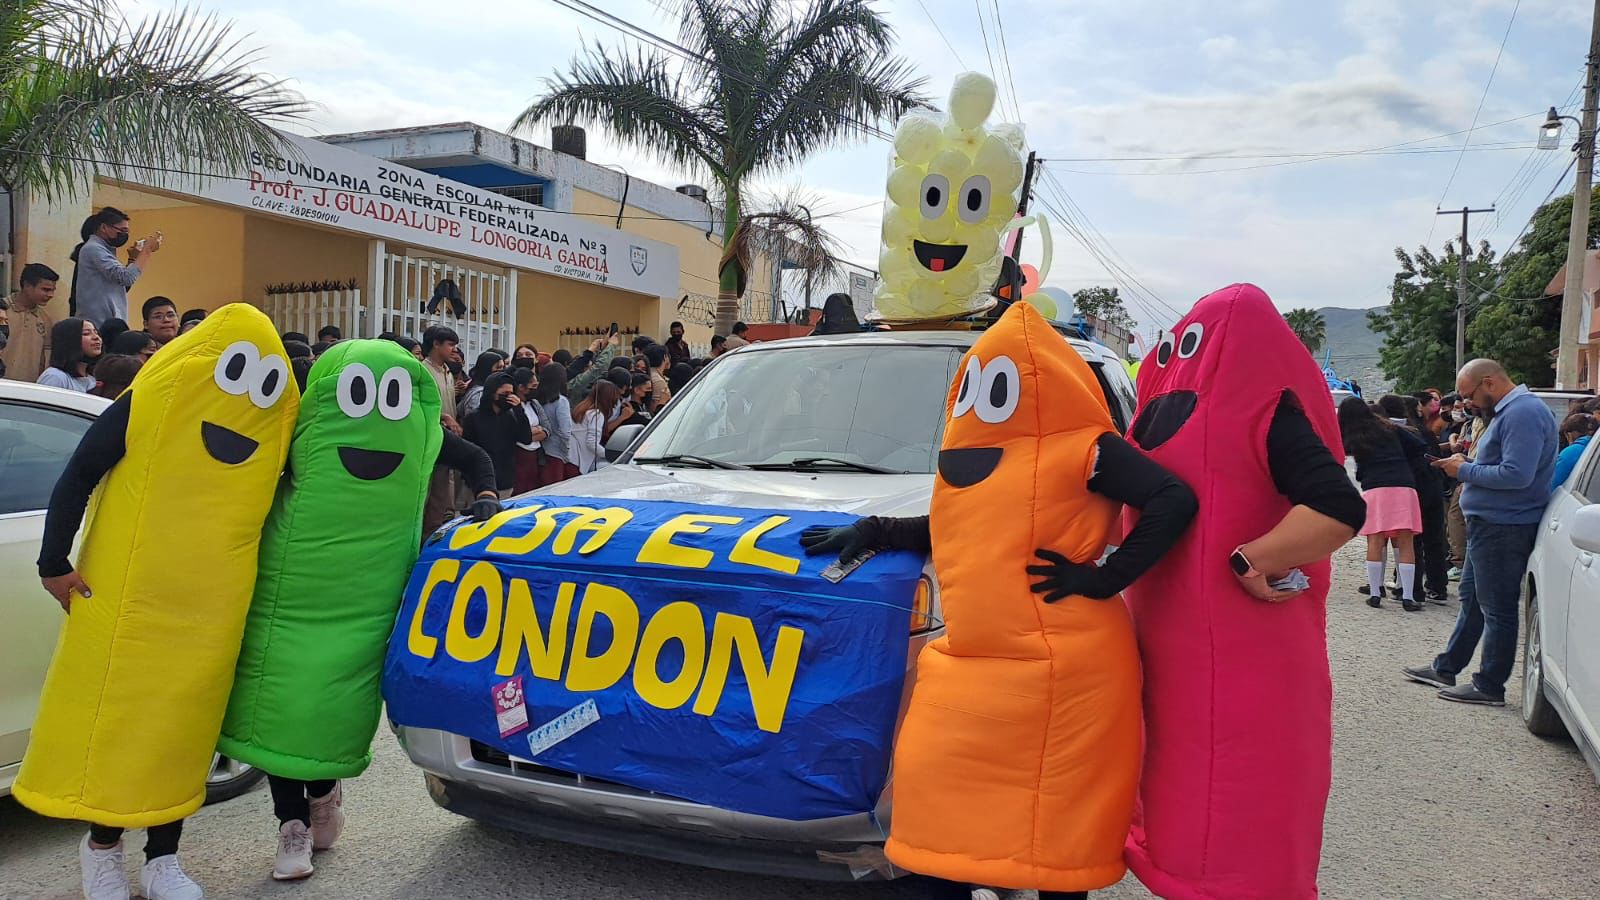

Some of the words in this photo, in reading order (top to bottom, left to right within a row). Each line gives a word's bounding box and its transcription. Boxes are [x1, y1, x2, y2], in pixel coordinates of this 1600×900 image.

[249, 170, 307, 203] Profr.
[312, 188, 330, 207] J.
[334, 192, 461, 238] GUADALUPE
[471, 225, 552, 260] LONGORIA
[250, 151, 371, 193] SECUNDARIA
[379, 185, 456, 216] GENERAL
[459, 206, 570, 246] FEDERALIZADA
[599, 243, 607, 256] 3
[251, 195, 288, 212] CLAVE:
[377, 166, 424, 190] ZONA
[436, 183, 503, 213] ESCOLAR
[524, 209, 535, 221] 14
[636, 513, 801, 575] EL
[407, 558, 804, 733] CONDON
